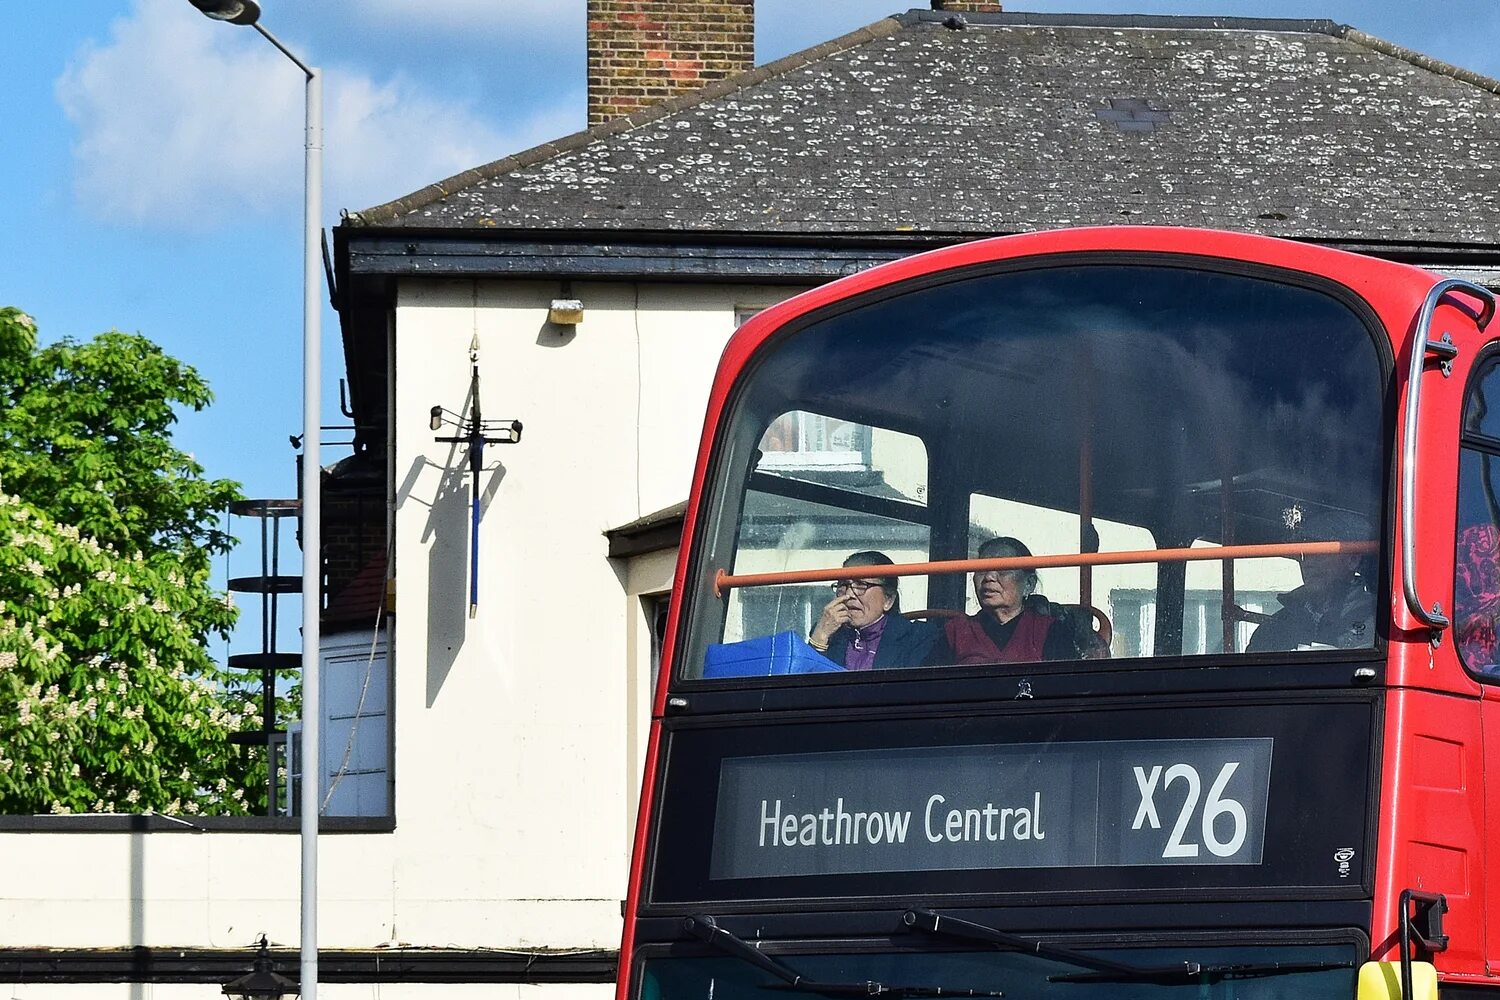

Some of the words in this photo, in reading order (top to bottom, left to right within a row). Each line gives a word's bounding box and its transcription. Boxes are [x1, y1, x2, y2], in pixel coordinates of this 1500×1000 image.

[759, 798, 911, 847] Heathrow
[925, 792, 1045, 843] Central
[1131, 762, 1248, 858] X26
